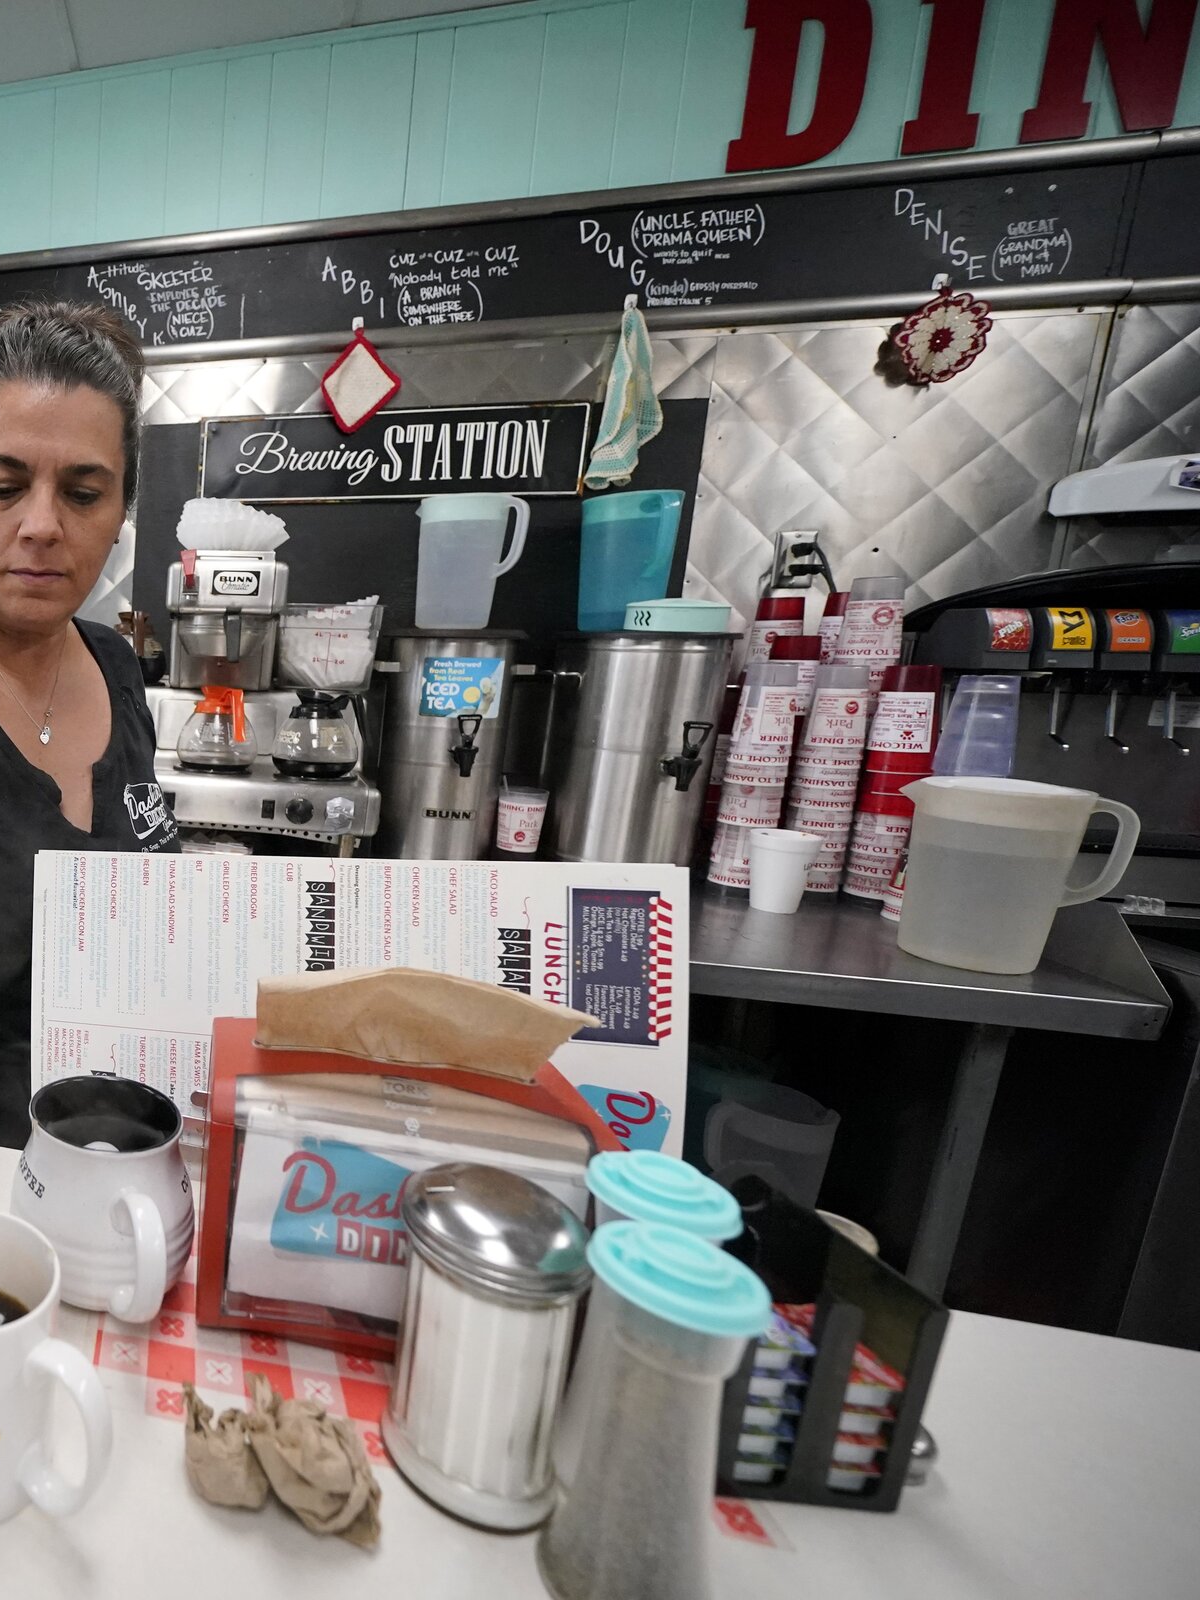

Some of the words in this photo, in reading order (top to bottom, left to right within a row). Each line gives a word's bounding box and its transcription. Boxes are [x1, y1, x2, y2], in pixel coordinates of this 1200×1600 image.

[700, 208, 757, 227] FATHER
[1007, 217, 1059, 237] GREAT
[642, 231, 693, 248] DRAMA
[695, 225, 751, 245] QUEEN
[390, 253, 418, 268] CUZ
[434, 249, 465, 264] CUZ
[485, 245, 520, 262] CUZ
[1000, 255, 1033, 268] MOM
[137, 267, 213, 290] SKEETER
[451, 265, 480, 280] told
[1021, 263, 1053, 278] MAW
[204, 285, 220, 299] OF
[420, 284, 461, 301] BRANCH
[175, 294, 227, 312] DECADE
[403, 301, 462, 317] SOMEWHERE
[408, 315, 423, 326] ON
[426, 313, 448, 325] THE
[450, 311, 475, 322] TREE
[235, 430, 379, 485] Brewing
[381, 419, 550, 482] STATION
[1115, 613, 1140, 624] Fanta
[454, 660, 481, 668] Brewed
[426, 682, 460, 696] ICED
[426, 696, 456, 710] TEA
[810, 737, 845, 745] DINER
[426, 809, 471, 819] BUNN
[802, 820, 835, 828] DINER
[412, 866, 420, 900] CHICKEN
[449, 867, 457, 888] CHEF
[449, 889, 457, 915] SALAD
[412, 901, 420, 927] SALAD
[167, 905, 175, 944] SANDWICH
[544, 922, 562, 1005] LUNCH
[385, 1081, 430, 1096] TORK
